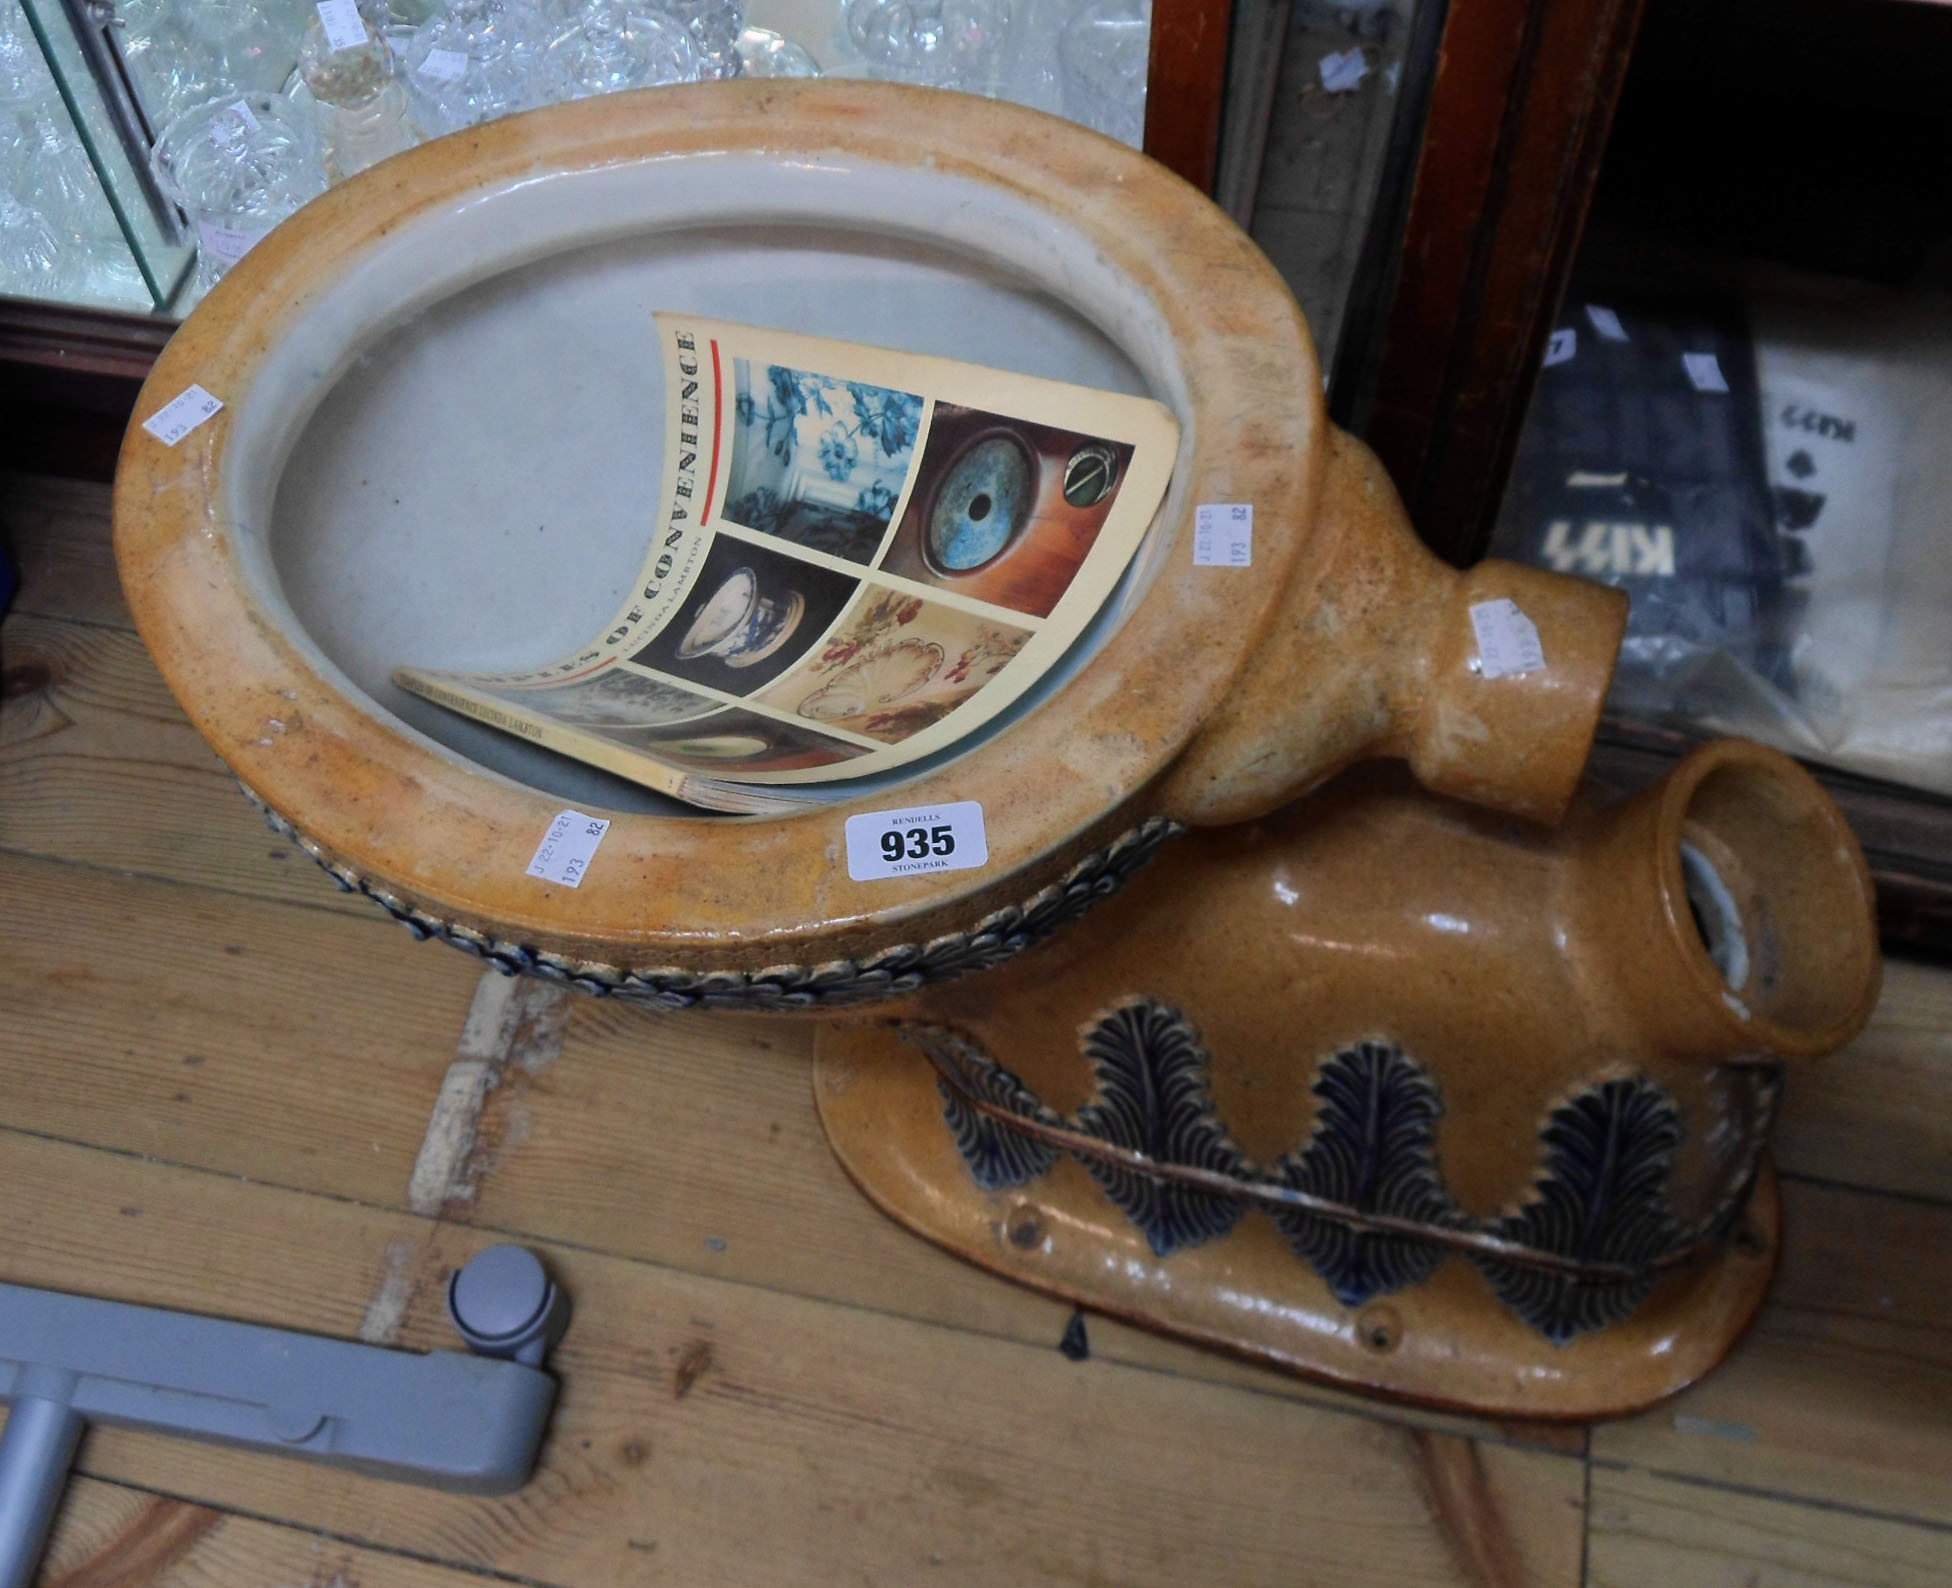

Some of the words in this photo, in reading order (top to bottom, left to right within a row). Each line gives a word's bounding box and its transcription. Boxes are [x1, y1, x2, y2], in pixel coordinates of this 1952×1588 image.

[201, 400, 218, 414] 82
[605, 604, 644, 645] OF
[643, 329, 699, 599] CONVENIENCE
[1231, 507, 1248, 521] 82
[1230, 542, 1248, 562] 193
[1542, 521, 1676, 576] KISS
[667, 536, 703, 604] LAMBTON
[508, 715, 545, 739] LAMBTON
[892, 814, 941, 826] RENDELLS
[562, 858, 585, 882] 193
[586, 822, 605, 836] 82
[880, 825, 956, 862] 935
[534, 865, 545, 874] J
[892, 860, 949, 873] STONEPARK
